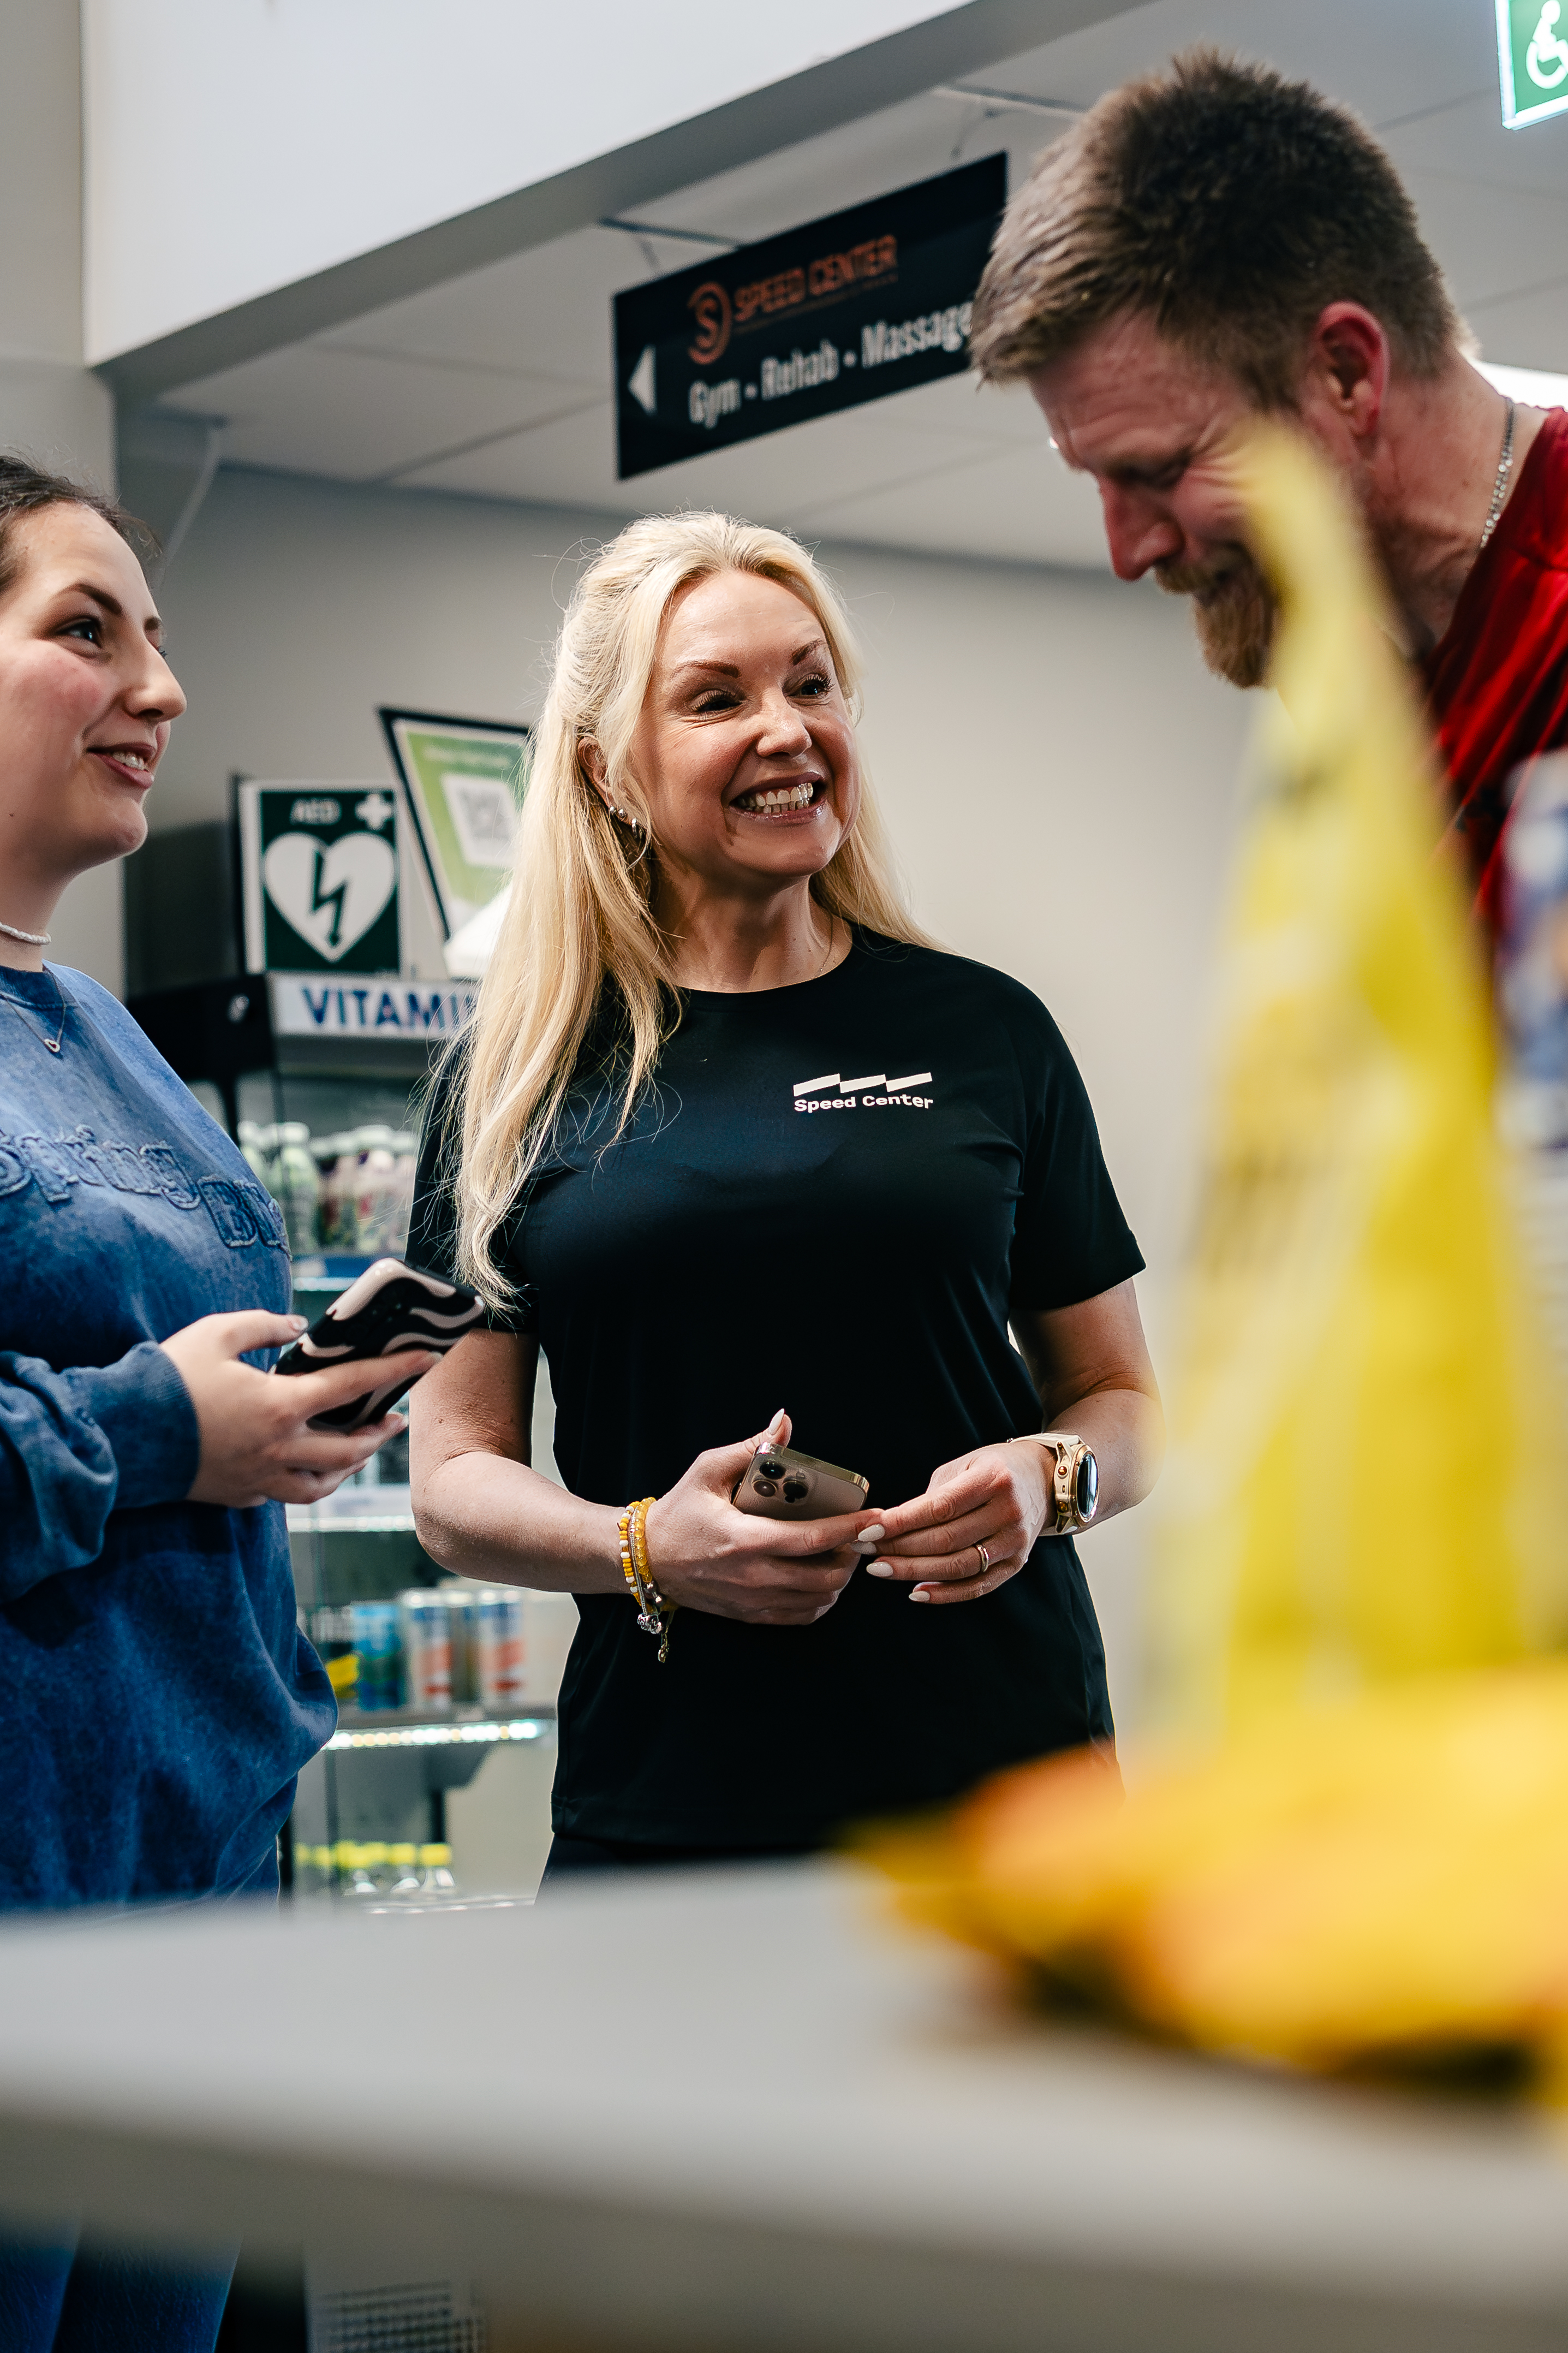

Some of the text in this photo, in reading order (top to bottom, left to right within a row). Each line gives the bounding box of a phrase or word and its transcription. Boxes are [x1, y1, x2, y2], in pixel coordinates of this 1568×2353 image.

[734, 268, 806, 322] SPEED
[809, 234, 898, 295] CENTER
[688, 379, 741, 429] Gym
[761, 338, 839, 400] Rehab
[794, 1094, 933, 1113] Speed Center
